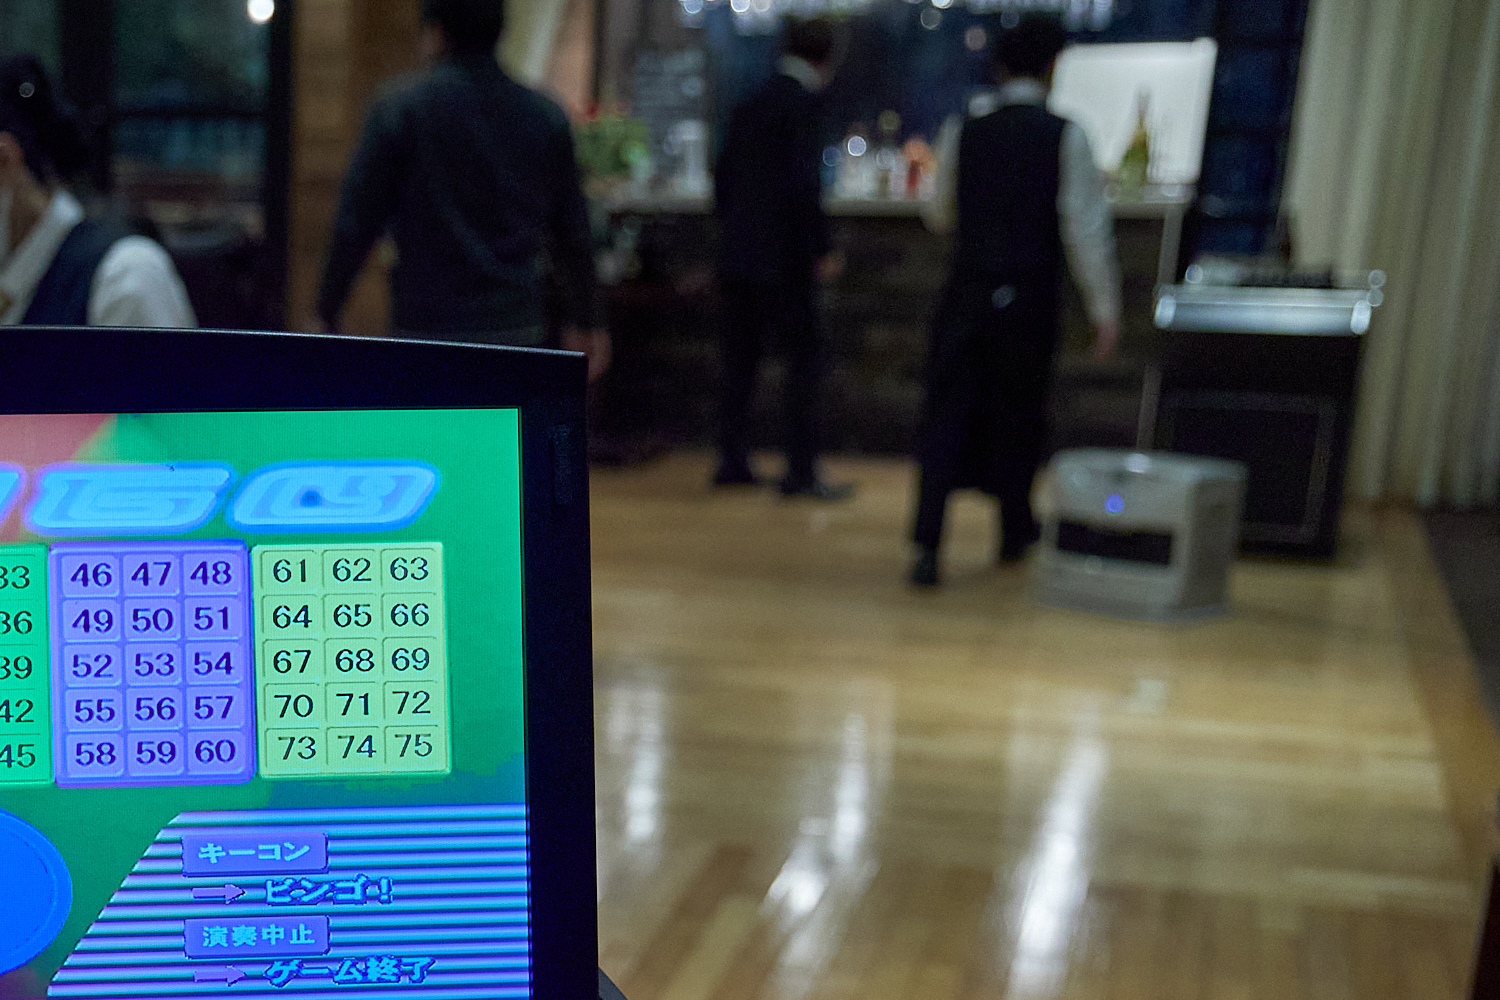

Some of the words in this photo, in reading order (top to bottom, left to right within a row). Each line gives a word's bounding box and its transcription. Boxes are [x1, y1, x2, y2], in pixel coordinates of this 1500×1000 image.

[70, 562, 112, 588] 46
[131, 561, 172, 587] 47
[190, 561, 232, 586] 48
[272, 559, 306, 583] 61
[332, 558, 372, 582] 62
[389, 557, 429, 581] 63
[72, 609, 114, 633] 49
[132, 608, 174, 632] 50
[194, 606, 229, 630] 51
[272, 604, 313, 629] 64
[333, 603, 372, 628] 65
[390, 602, 430, 627] 66
[72, 654, 112, 678] 52
[134, 653, 175, 677] 53
[194, 651, 233, 675] 54
[273, 649, 312, 674] 67
[335, 648, 375, 673] 68
[391, 647, 430, 672] 69
[75, 698, 116, 722] 55
[135, 696, 176, 721] 56
[194, 695, 234, 720] 57
[274, 694, 314, 719] 70
[336, 692, 369, 716] 71
[392, 690, 431, 715] 72
[76, 742, 117, 766] 58
[136, 740, 176, 764] 59
[194, 739, 236, 763] 60
[278, 736, 317, 761] 73
[339, 734, 377, 759] 74
[396, 733, 433, 758] 75
[197, 842, 311, 864] キーコン
[202, 925, 316, 947] 演奏中止
[264, 956, 436, 986] ゲーム終了
